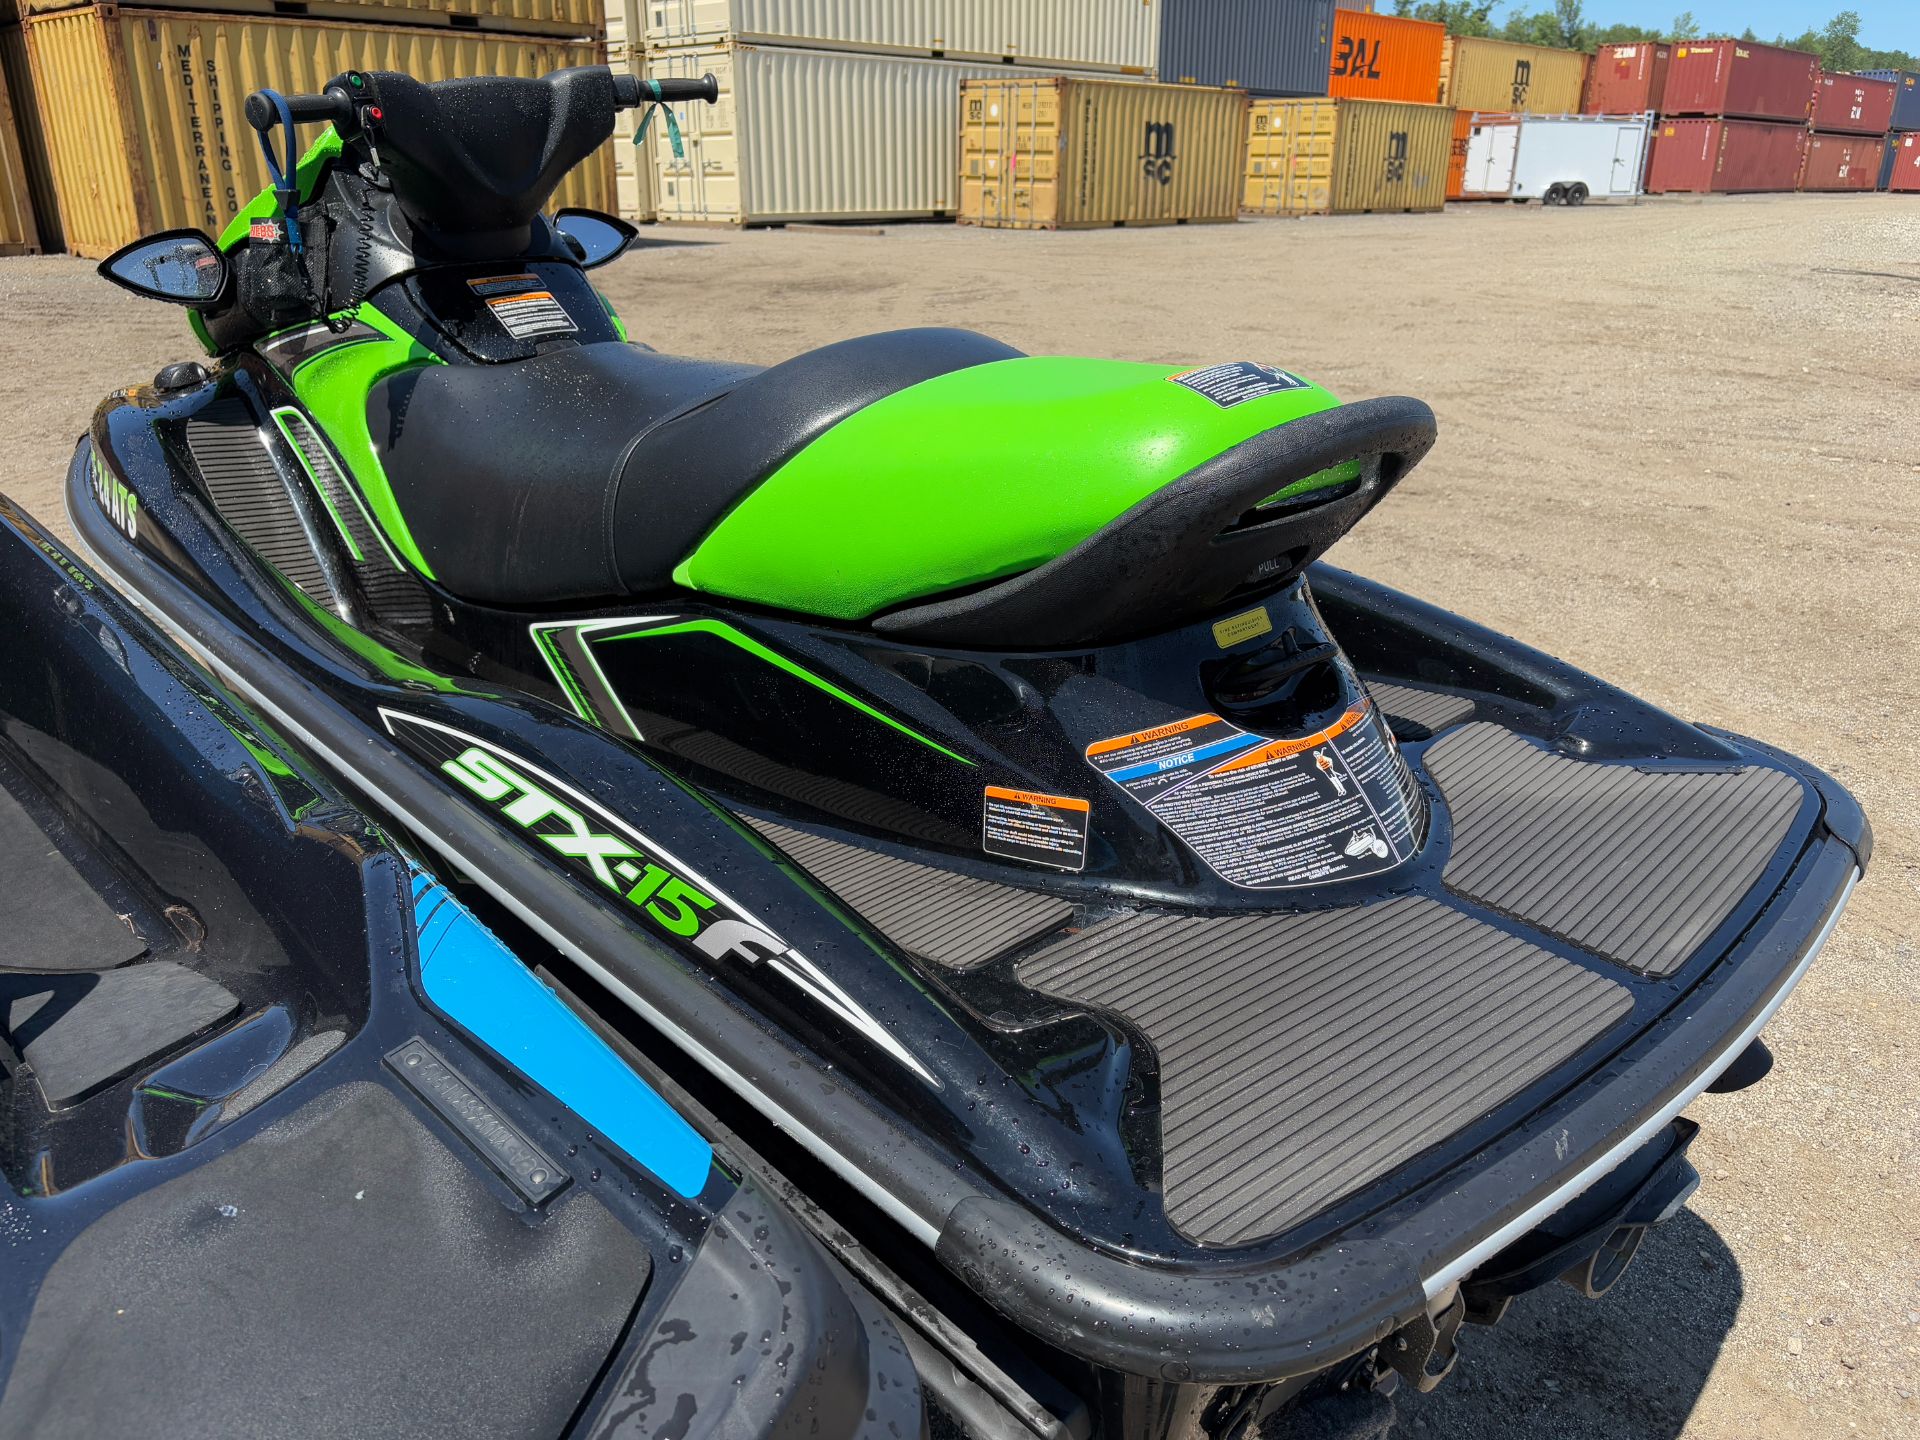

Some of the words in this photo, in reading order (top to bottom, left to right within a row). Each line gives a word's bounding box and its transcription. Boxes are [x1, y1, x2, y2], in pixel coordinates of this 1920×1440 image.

[177, 44, 217, 226] MEDITERRANEAN
[206, 60, 232, 171] SHIPPING
[226, 186, 237, 212] CO
[1258, 559, 1279, 574] PULL
[1141, 722, 1189, 741] WARNING
[1274, 740, 1311, 757] WARNING
[1158, 753, 1195, 770] NOTICE
[1022, 794, 1057, 805] WARNING
